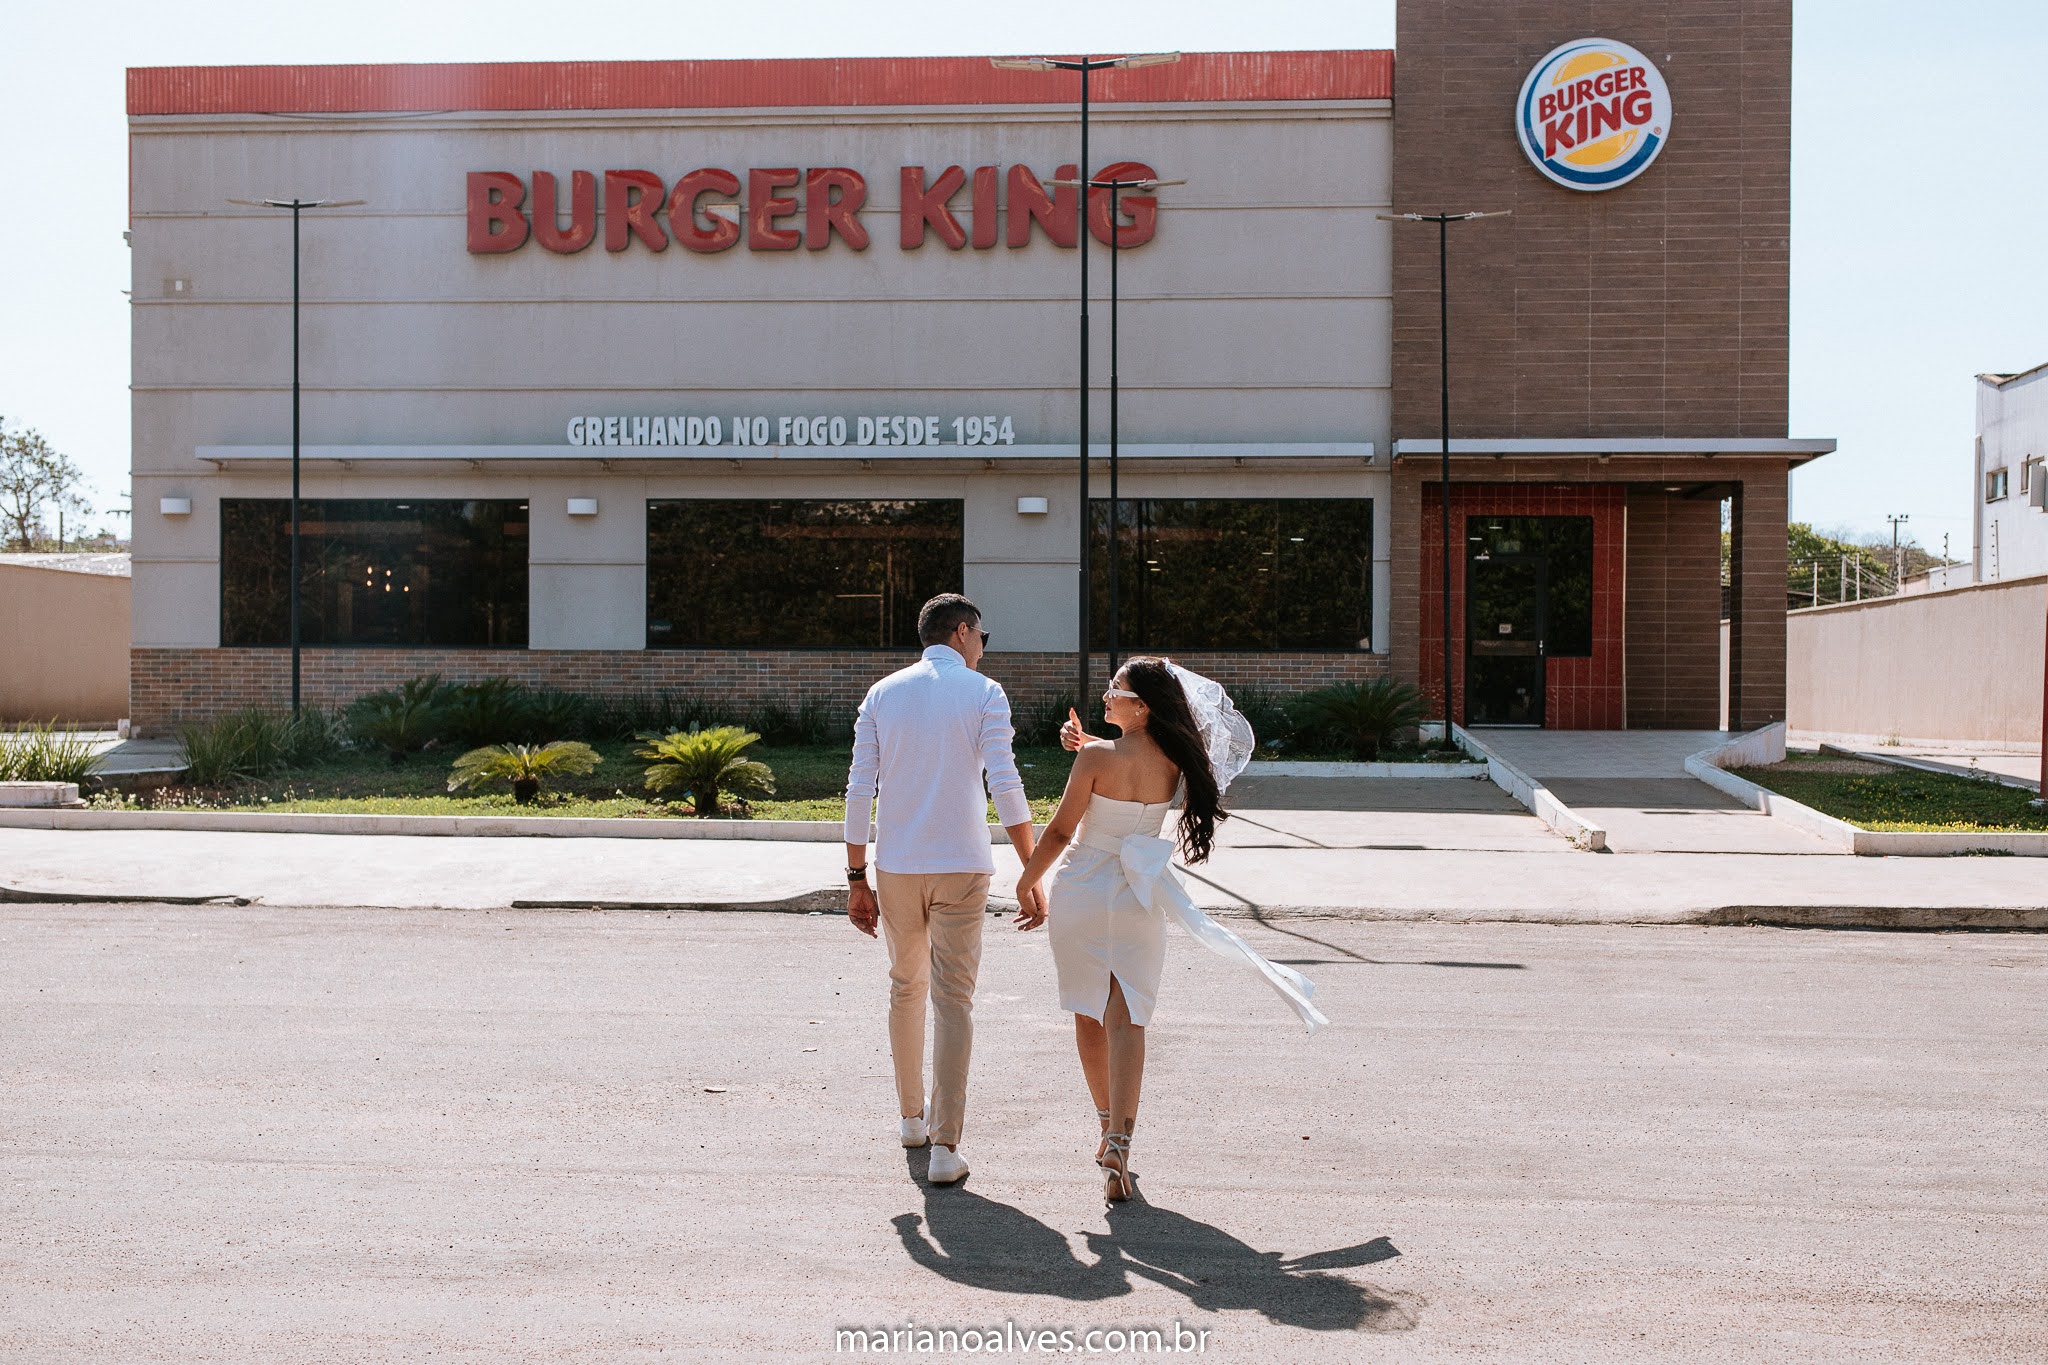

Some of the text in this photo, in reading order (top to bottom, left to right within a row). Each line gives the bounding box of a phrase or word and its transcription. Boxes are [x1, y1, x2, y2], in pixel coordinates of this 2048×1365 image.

[1539, 66, 1648, 124] BURGER
[1545, 89, 1653, 159] KING
[466, 161, 1159, 255] BURGER KING
[566, 415, 1016, 447] GRELHANDO NO FOGO DESDE 1954
